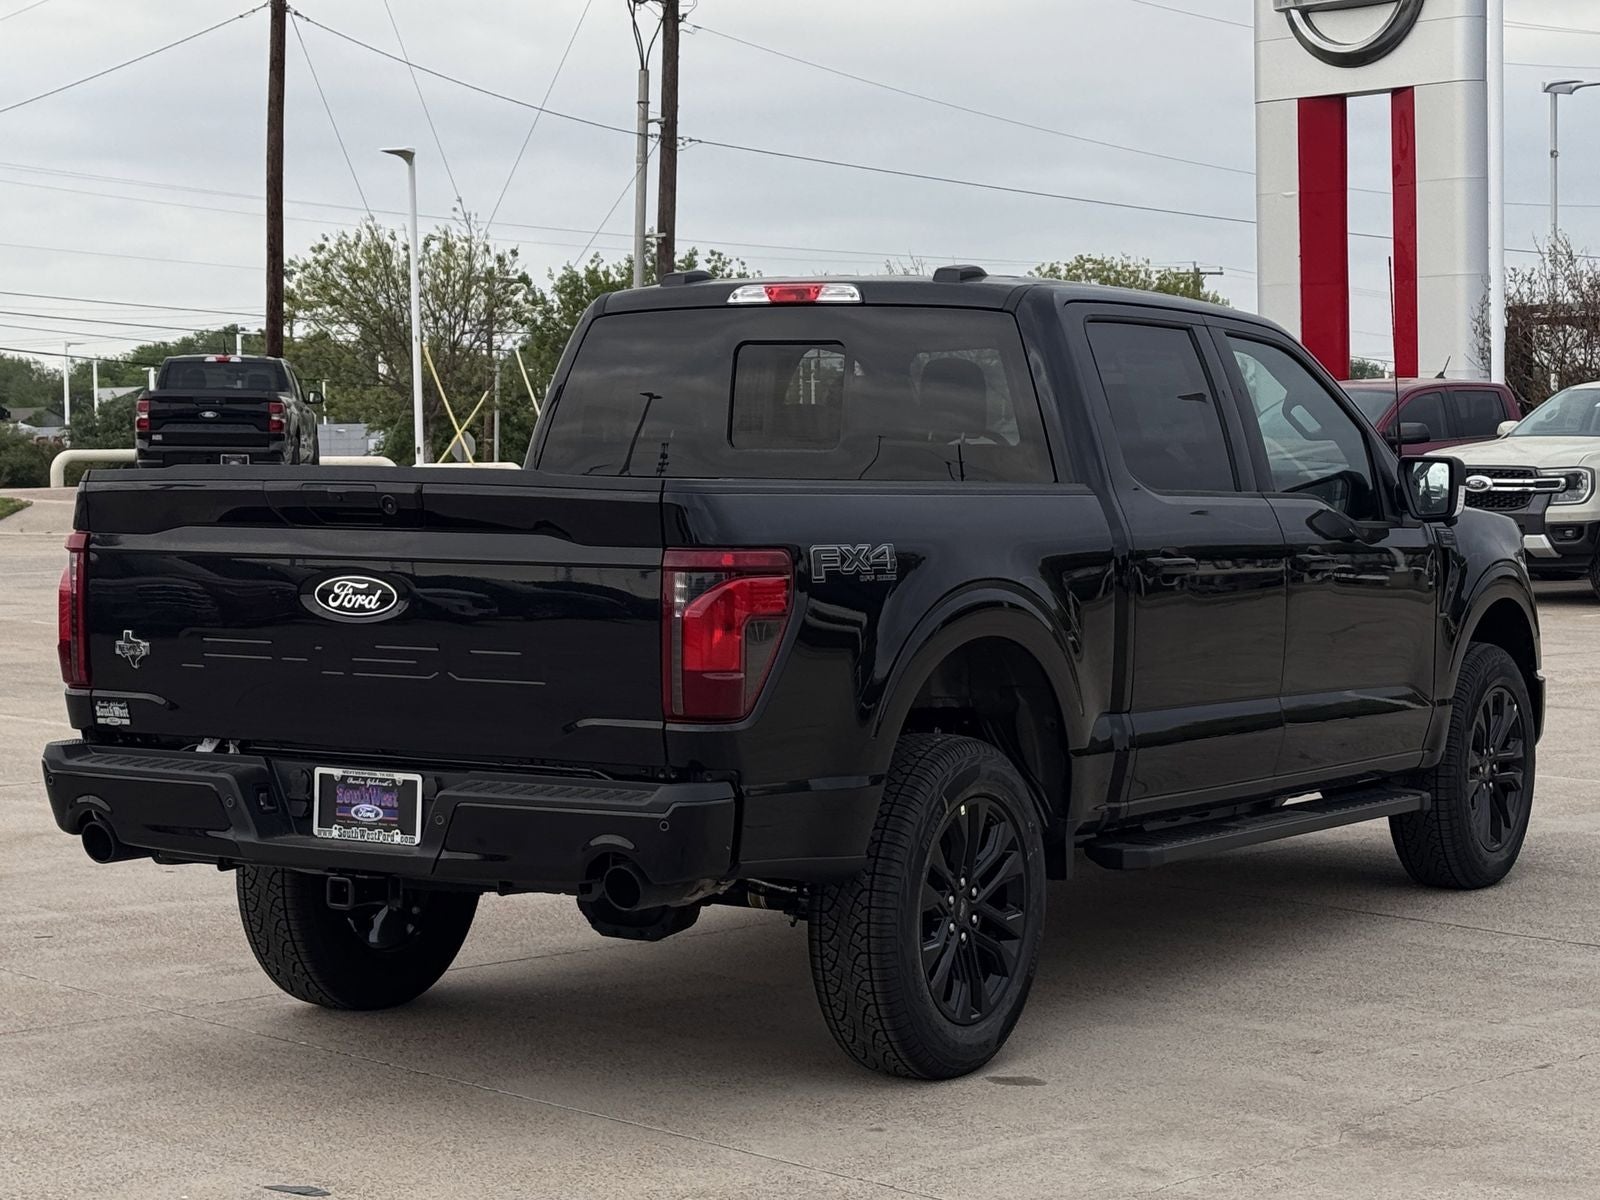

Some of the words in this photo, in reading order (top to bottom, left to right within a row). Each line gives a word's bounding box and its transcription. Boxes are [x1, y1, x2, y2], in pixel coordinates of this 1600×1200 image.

[810, 543, 897, 583] FX4
[328, 580, 381, 609] Ford
[336, 784, 399, 808] SouthWest
[358, 807, 376, 819] Ford
